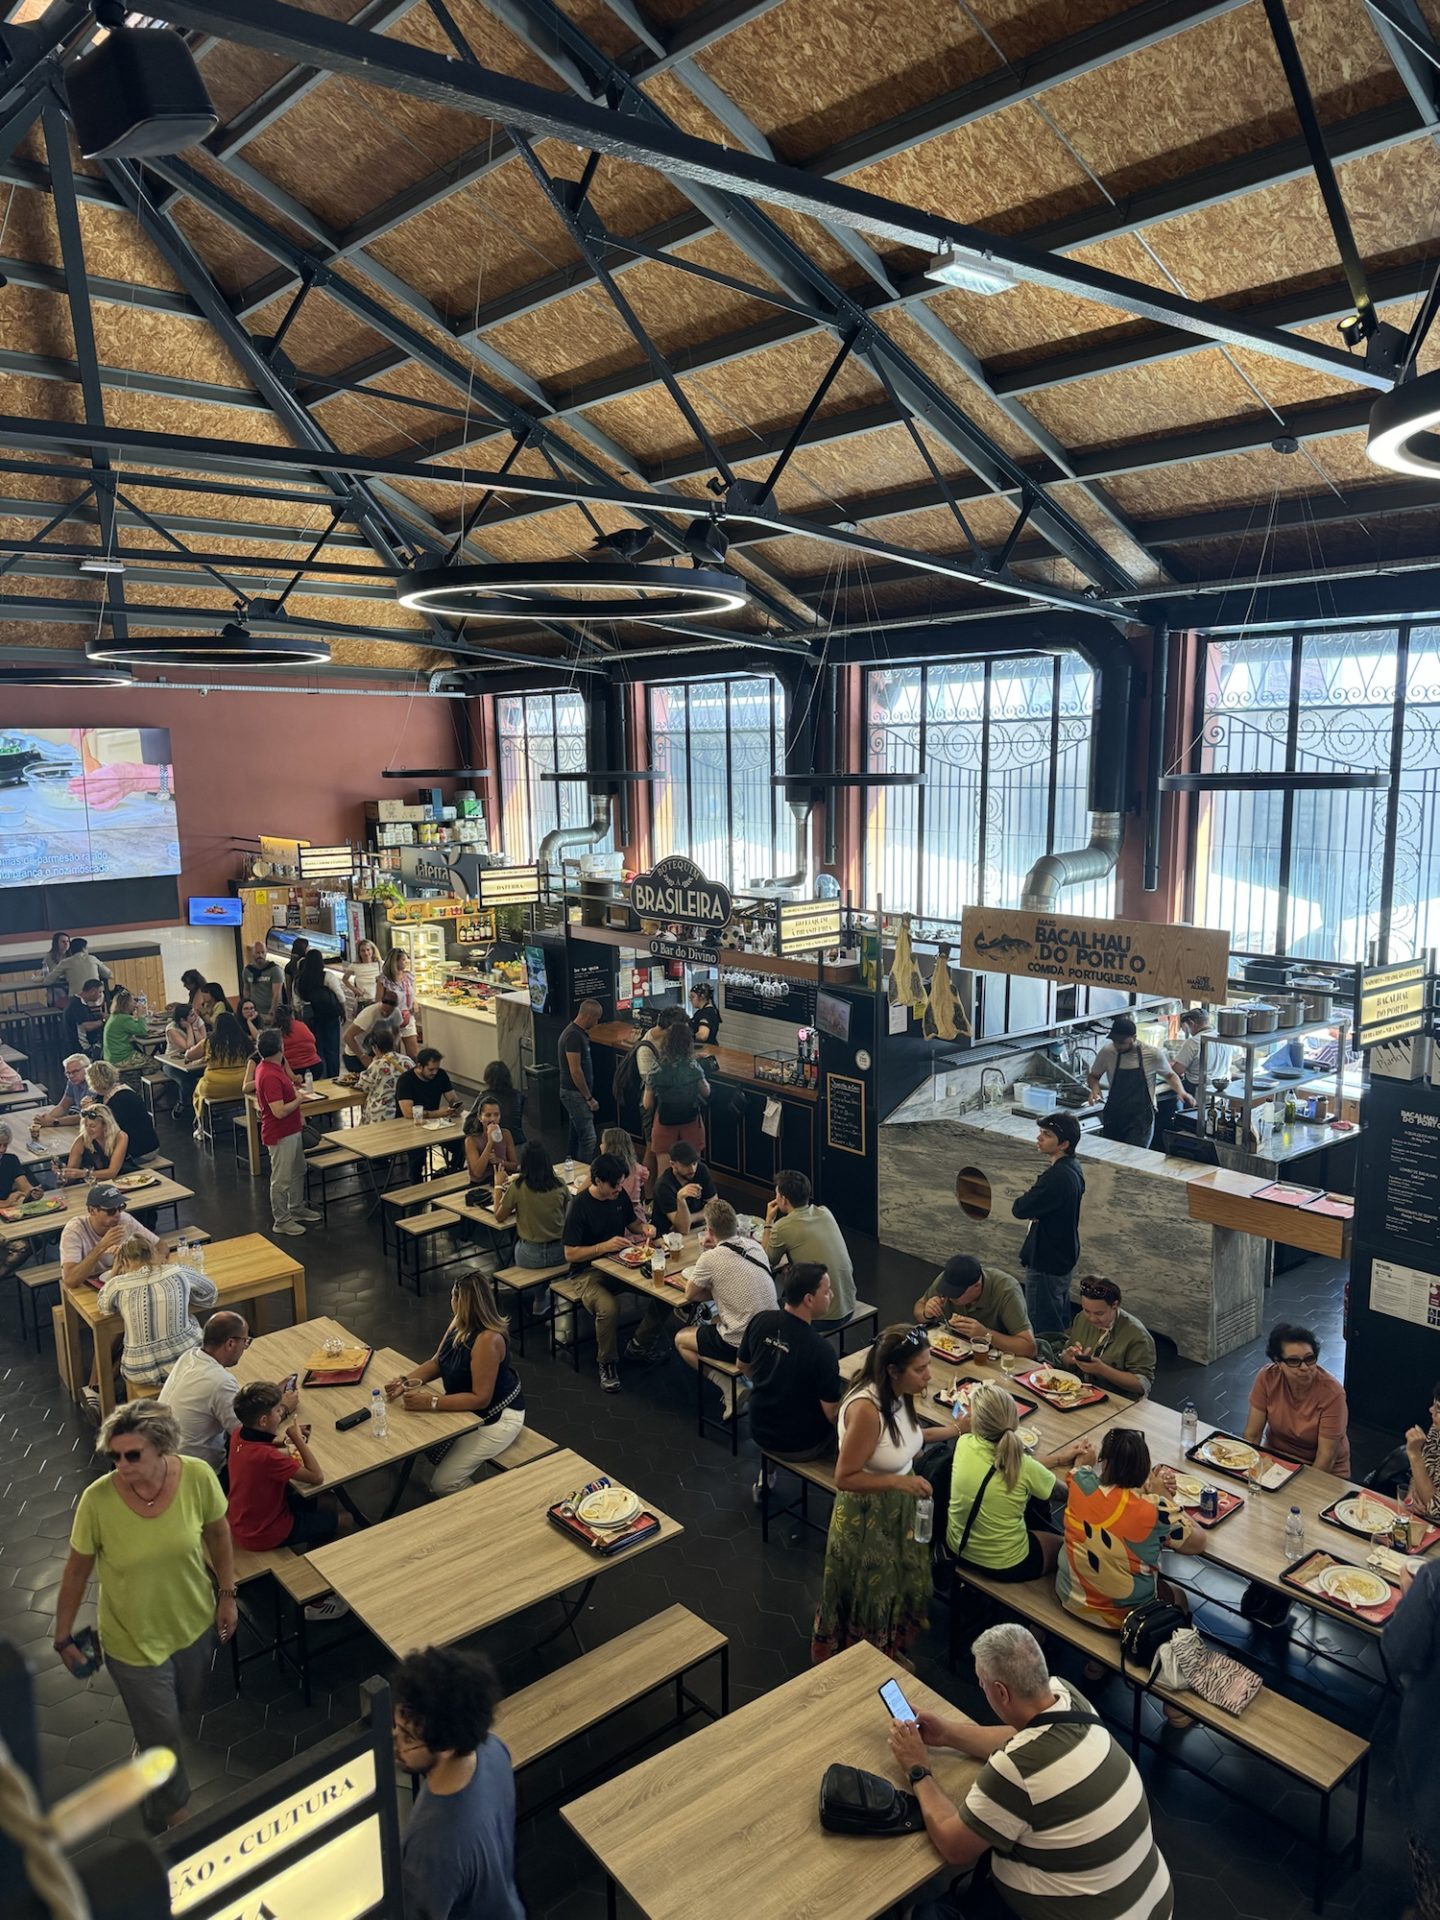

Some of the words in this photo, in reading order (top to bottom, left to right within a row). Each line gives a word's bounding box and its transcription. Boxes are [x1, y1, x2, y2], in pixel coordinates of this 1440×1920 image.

[657, 860, 700, 880] BOTEQUIM
[635, 884, 725, 921] BRASILEIRA
[650, 941, 658, 953] O
[660, 943, 674, 956] Bar
[675, 945, 686, 957] do
[688, 947, 717, 964] Divino
[1035, 926, 1132, 953] BACALHAU
[1039, 943, 1069, 964] DO
[1076, 947, 1146, 974] PORTO
[1027, 962, 1065, 976] COMIDA
[1068, 967, 1138, 987] PORTUGUESA
[239, 1777, 355, 1856] CULTURA
